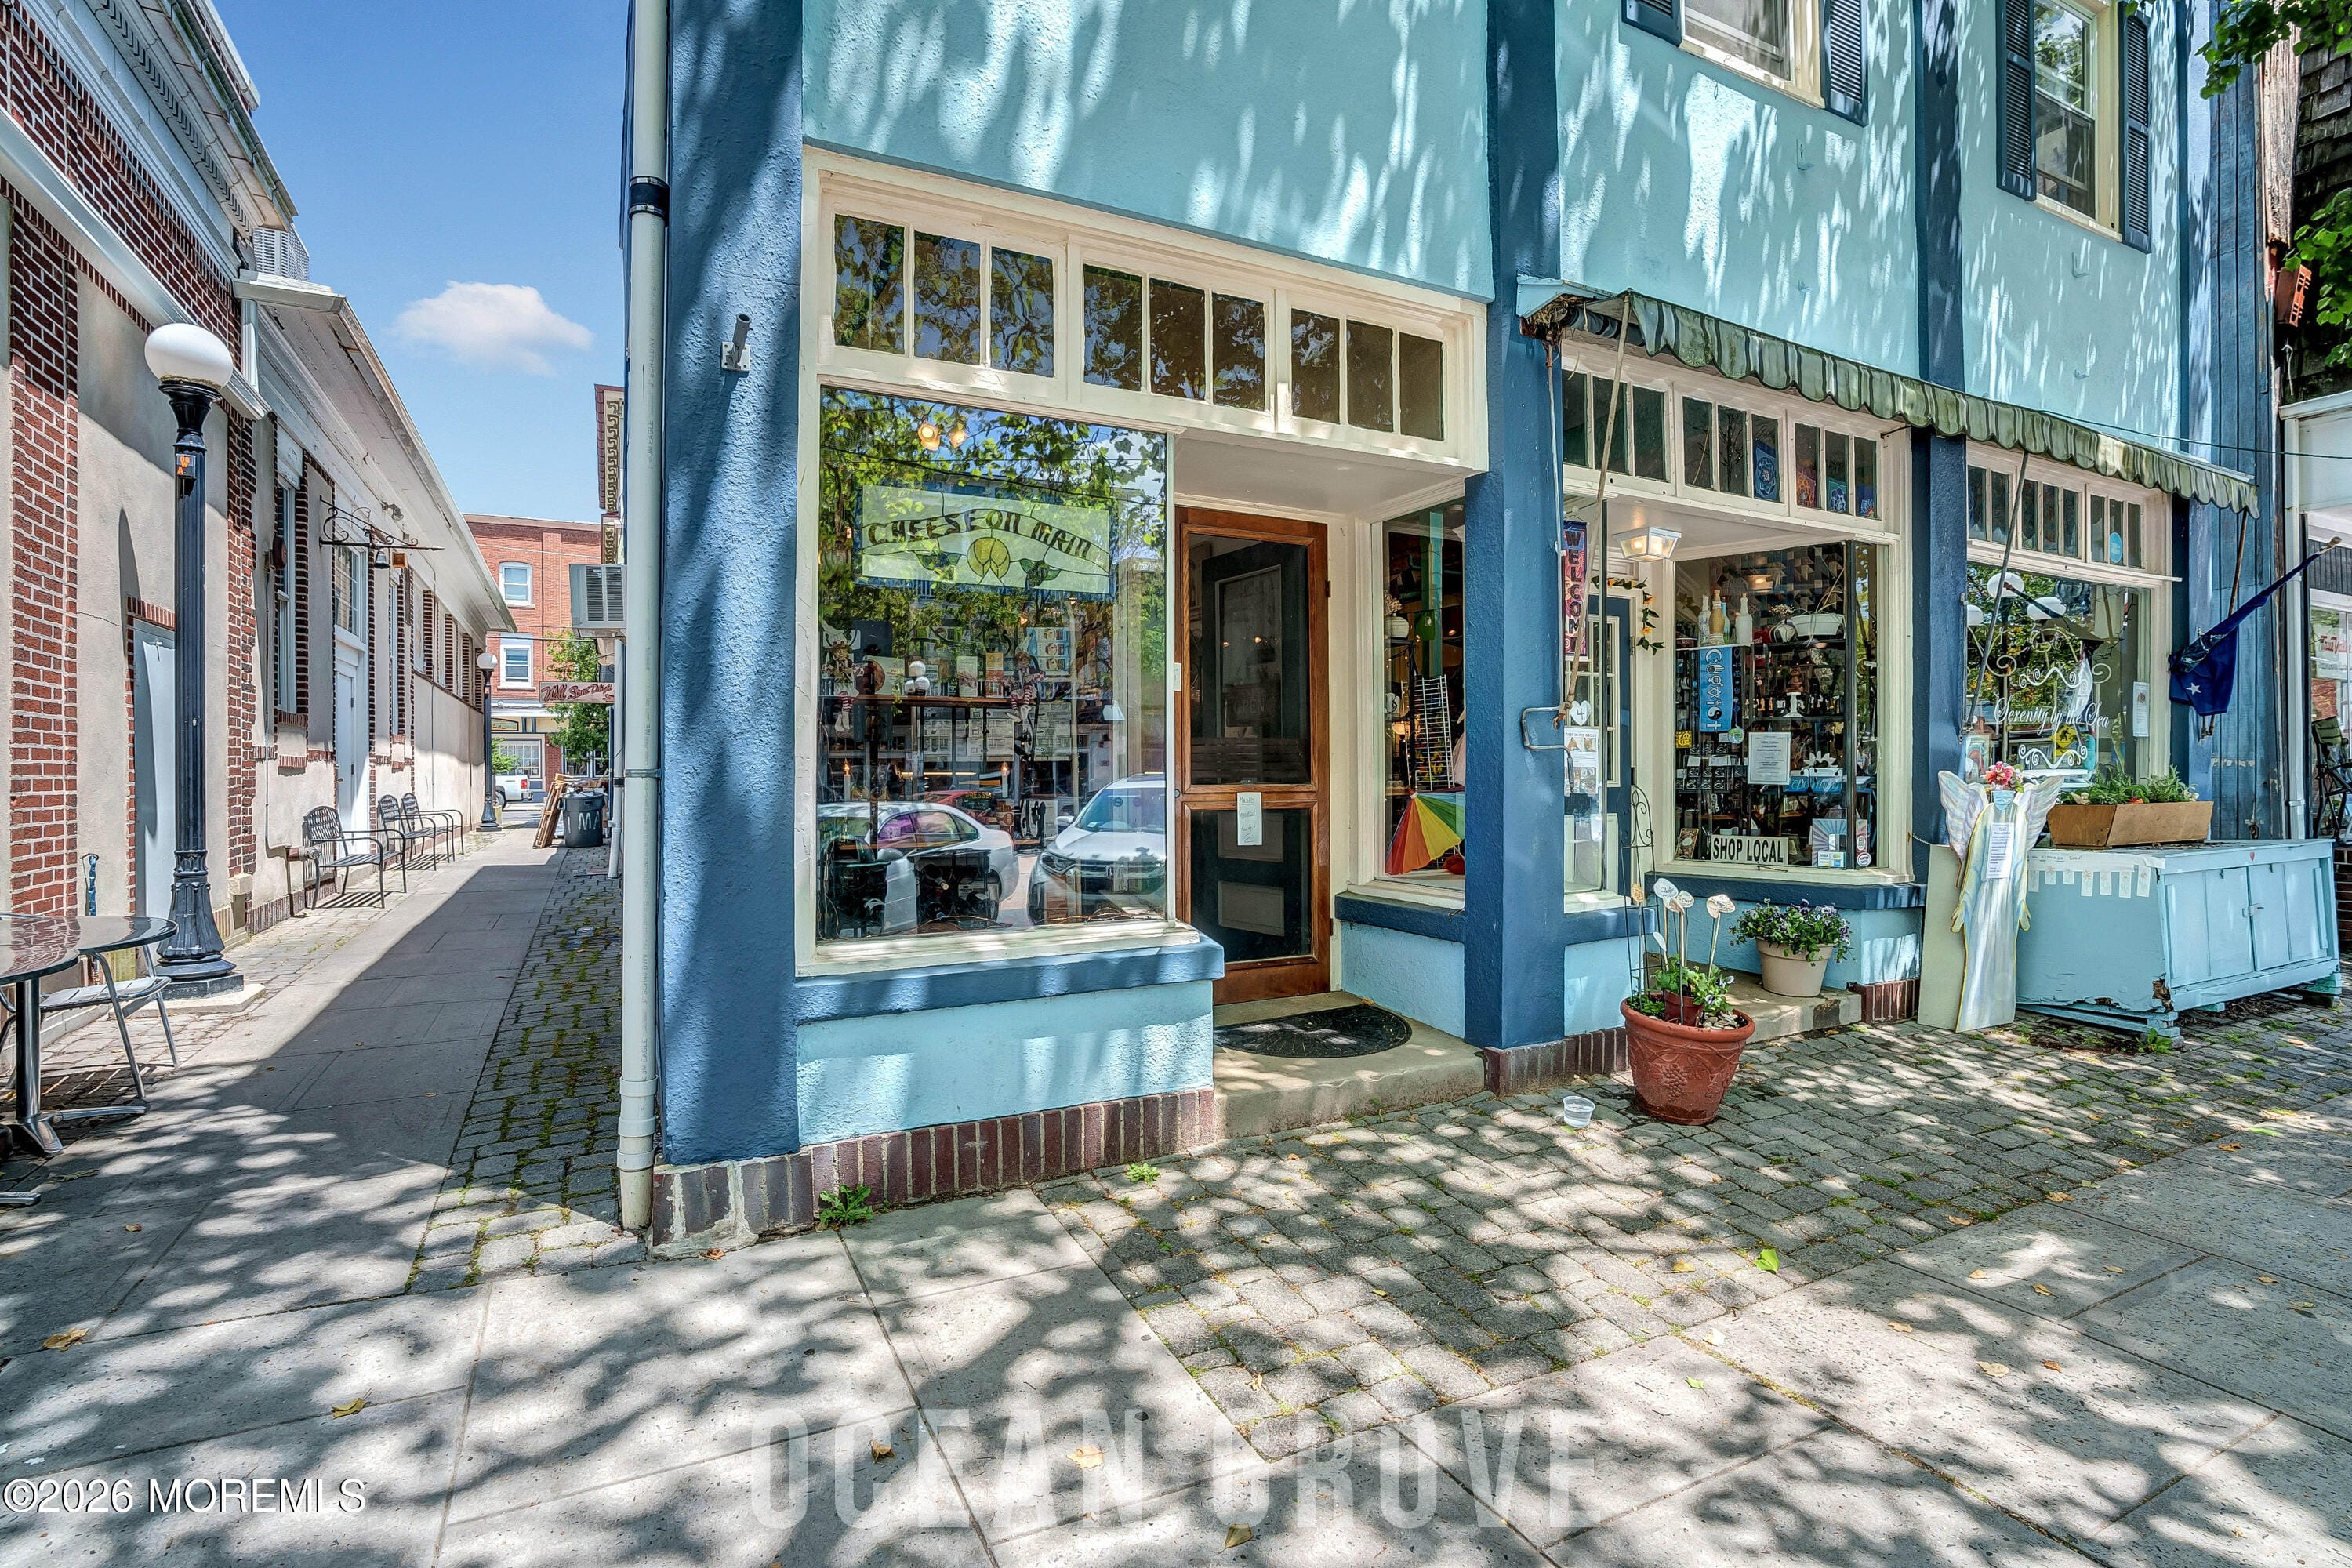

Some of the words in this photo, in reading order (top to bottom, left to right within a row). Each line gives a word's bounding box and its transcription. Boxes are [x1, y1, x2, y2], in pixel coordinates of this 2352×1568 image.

[867, 509, 985, 545] CHEESE
[1030, 521, 1092, 559] MAIN
[1577, 708, 1584, 721] 4
[1994, 695, 2049, 735] Serenity
[2050, 705, 2063, 735] by
[2065, 705, 2082, 724] the
[2085, 702, 2111, 728] Sea
[1243, 833, 1254, 843] 2
[1712, 837, 1743, 861] SHOP
[1747, 839, 1784, 863] LOCAL
